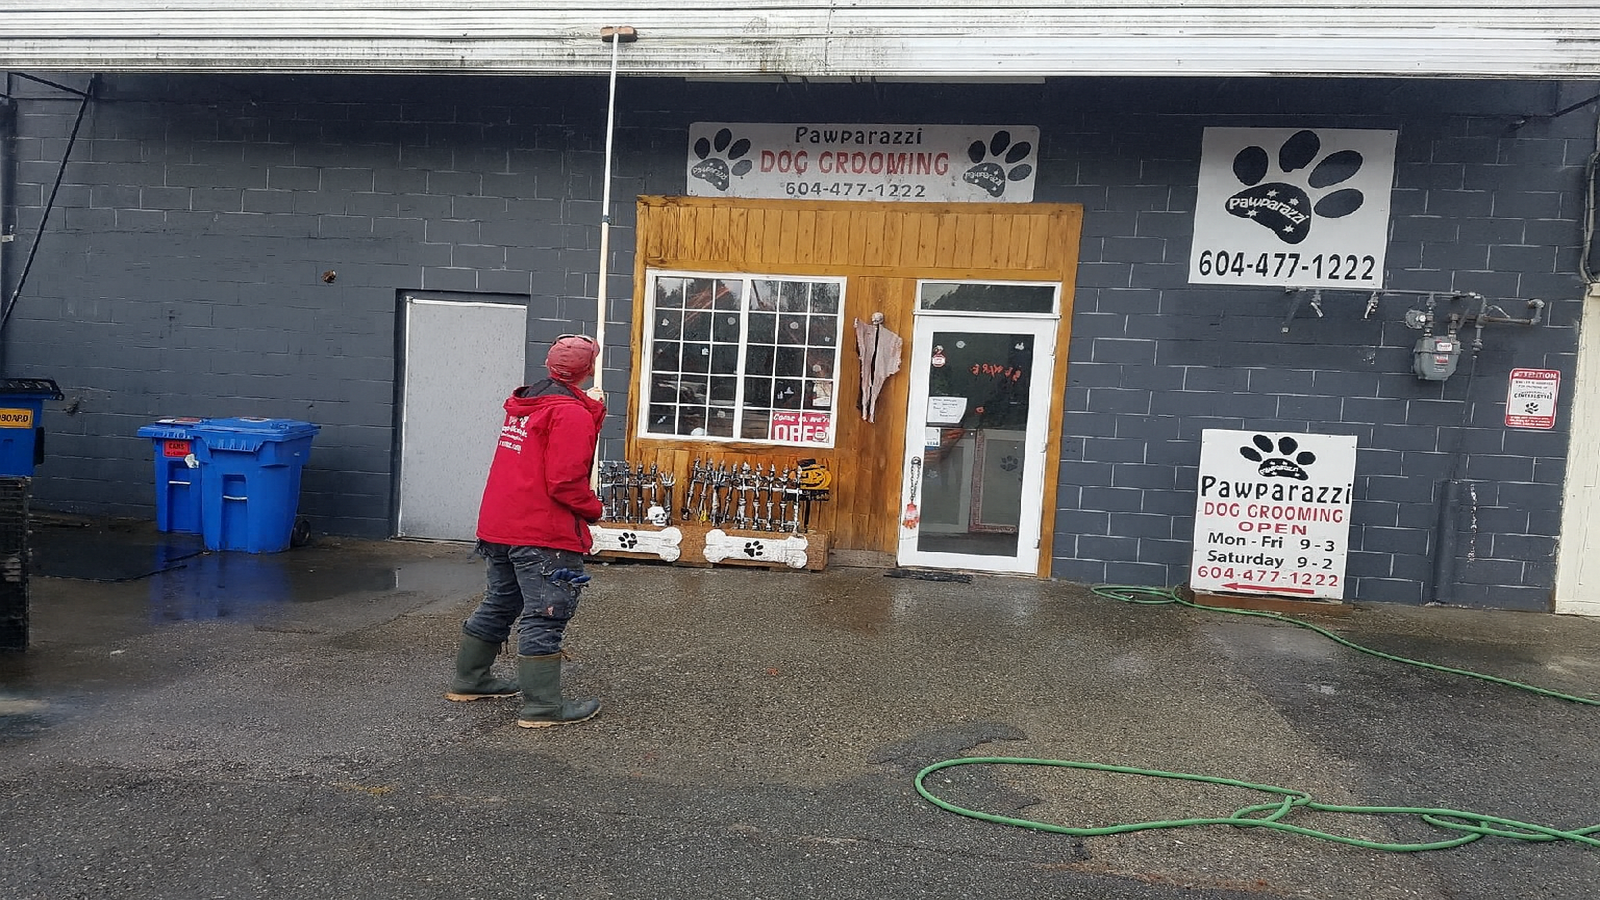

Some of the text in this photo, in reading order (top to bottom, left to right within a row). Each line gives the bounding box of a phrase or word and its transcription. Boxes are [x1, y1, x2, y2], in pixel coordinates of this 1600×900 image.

[795, 126, 922, 146] Pawparazzi
[759, 150, 950, 176] DOG GROOMING
[785, 182, 926, 198] 604-477-1222
[1229, 196, 1310, 225] Pawparazzi
[1198, 249, 1376, 281] 604-477-1222
[0, 414, 29, 422] BOARD
[773, 413, 796, 422] Come
[1201, 475, 1352, 505] Pawparazzi
[1204, 502, 1344, 523] DOG GROOMING
[1238, 521, 1307, 535] OPEN
[1207, 532, 1246, 546] Mon
[1261, 536, 1283, 549] Fri
[1206, 550, 1284, 569] Saturday
[1197, 565, 1338, 587] 604-477-1222
